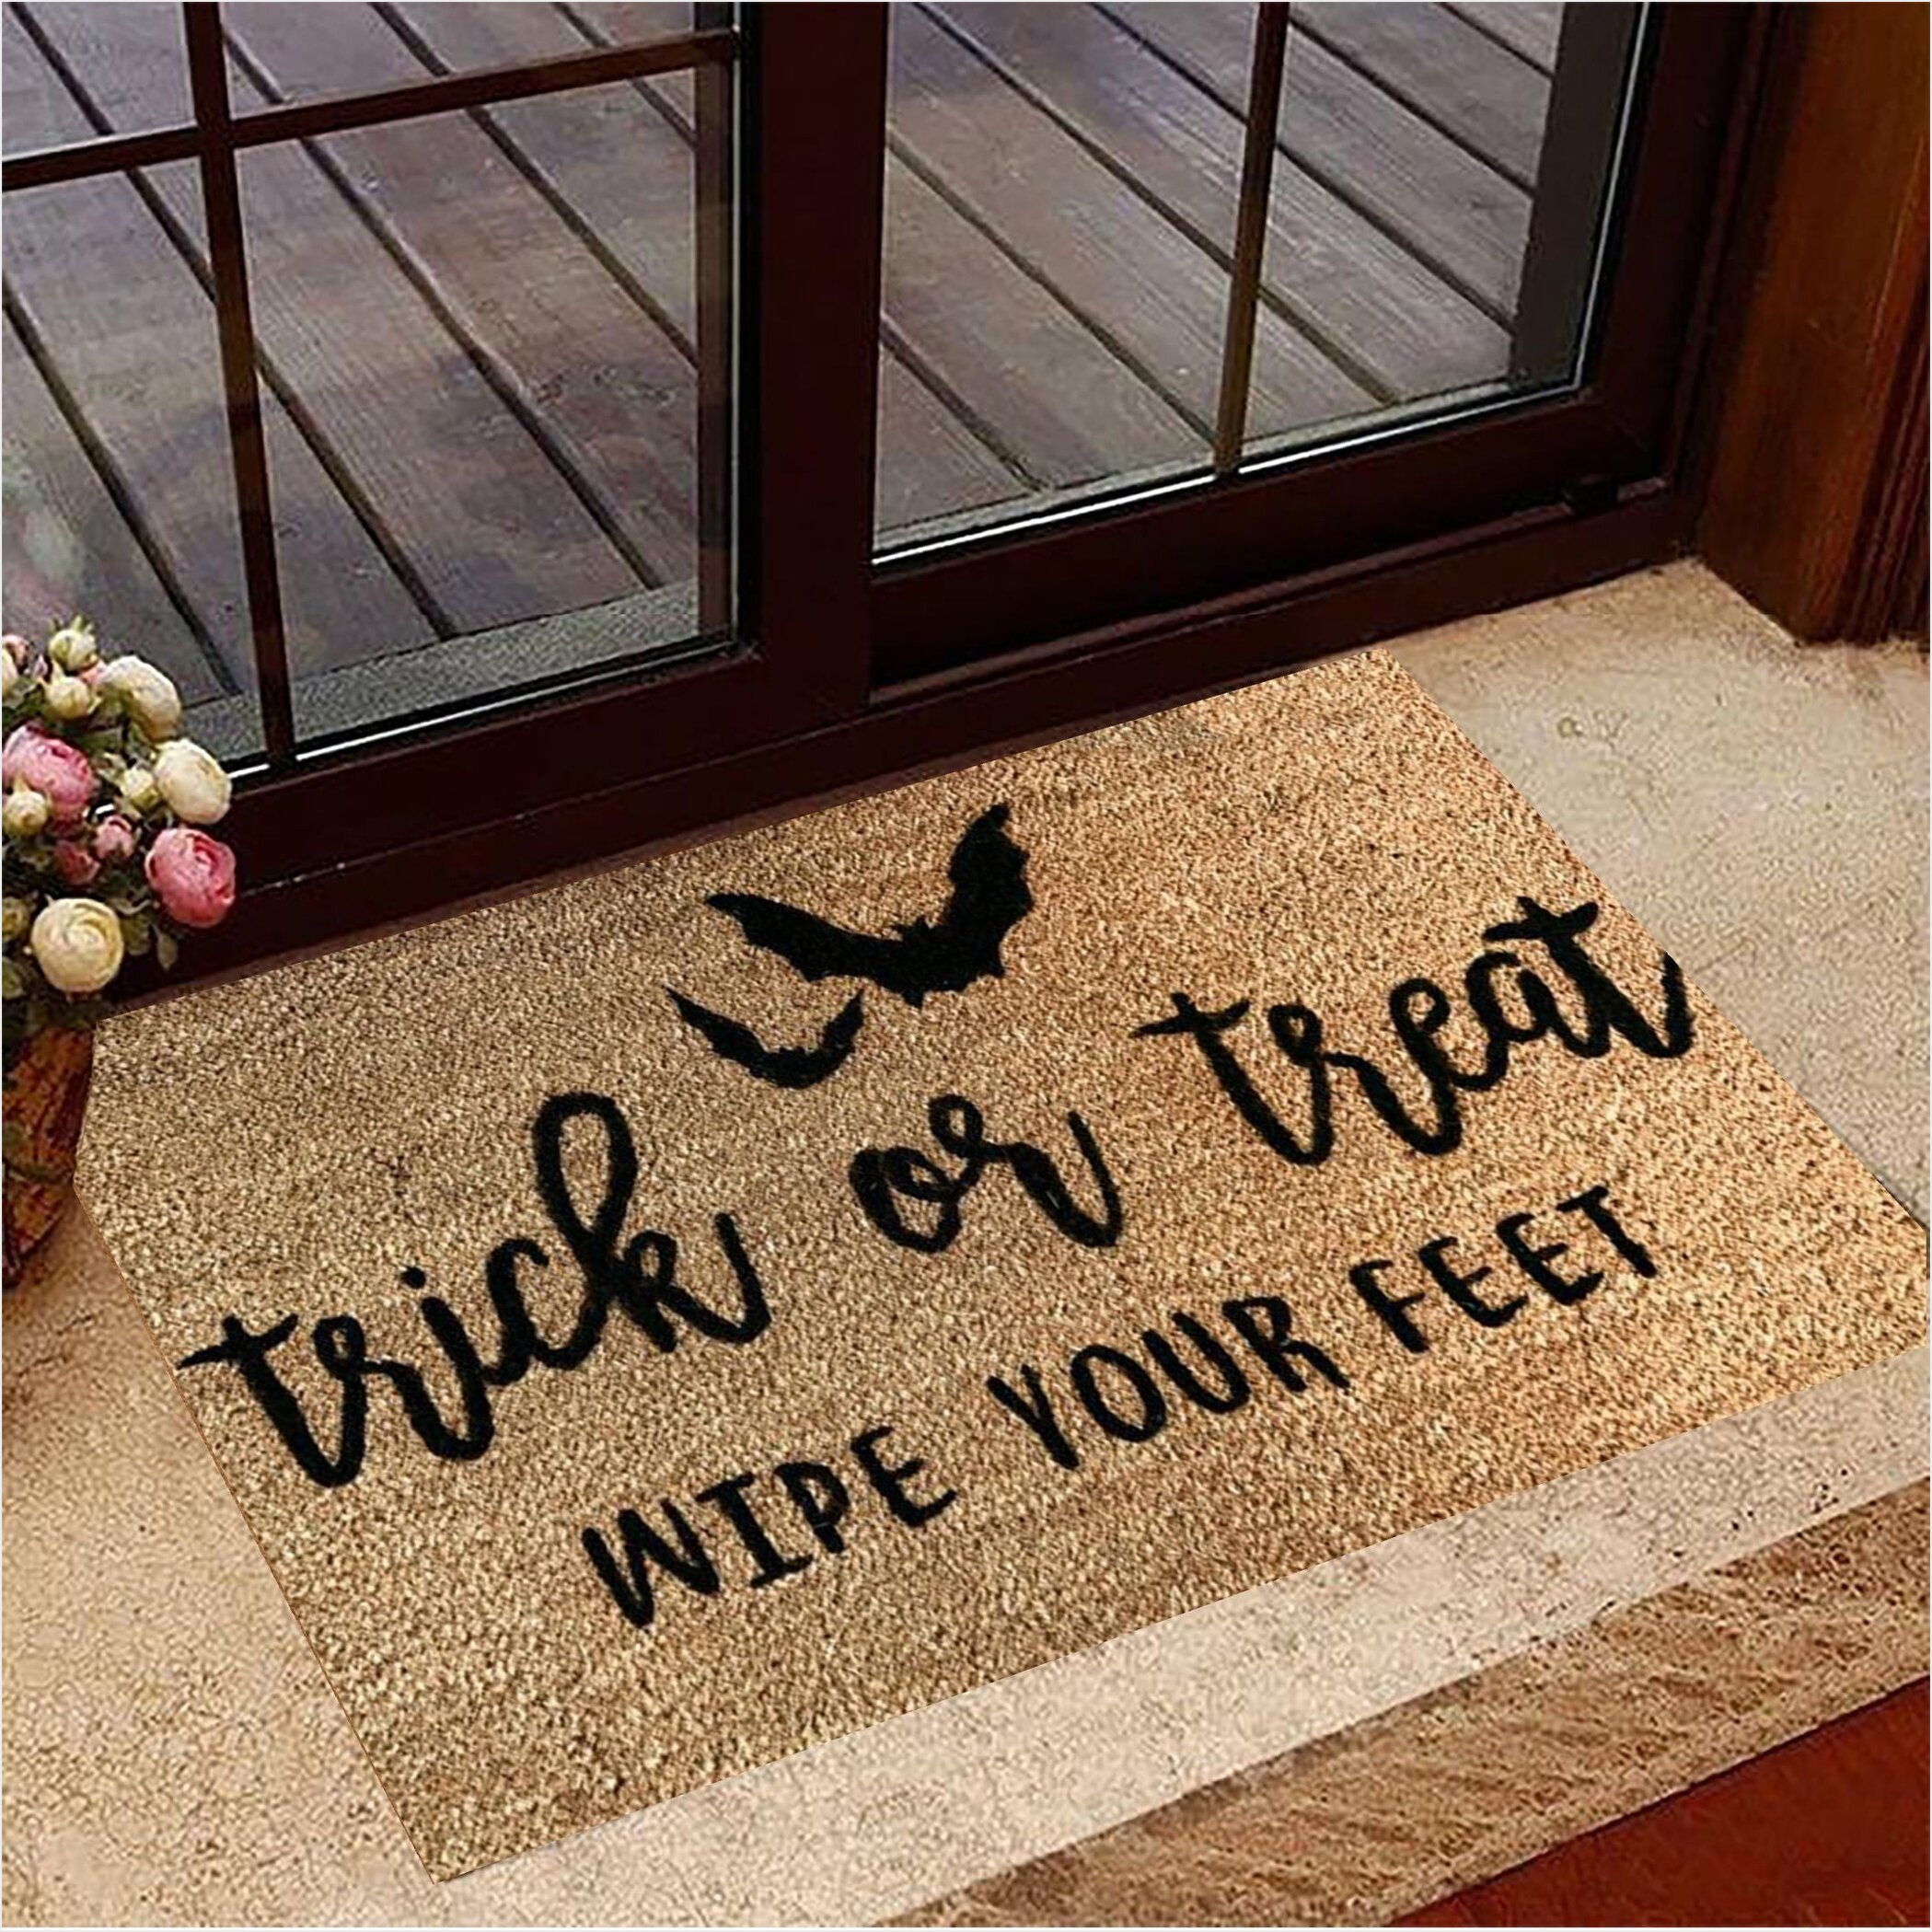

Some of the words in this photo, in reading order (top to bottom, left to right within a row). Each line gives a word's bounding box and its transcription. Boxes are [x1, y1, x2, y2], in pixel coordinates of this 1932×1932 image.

[177, 1090, 771, 1488] trick
[848, 1093, 1125, 1255] or
[1132, 896, 1695, 1166] treat
[581, 1425, 958, 1628] WIPE
[987, 1296, 1349, 1471] YOUR
[1349, 1185, 1660, 1353] FEET
